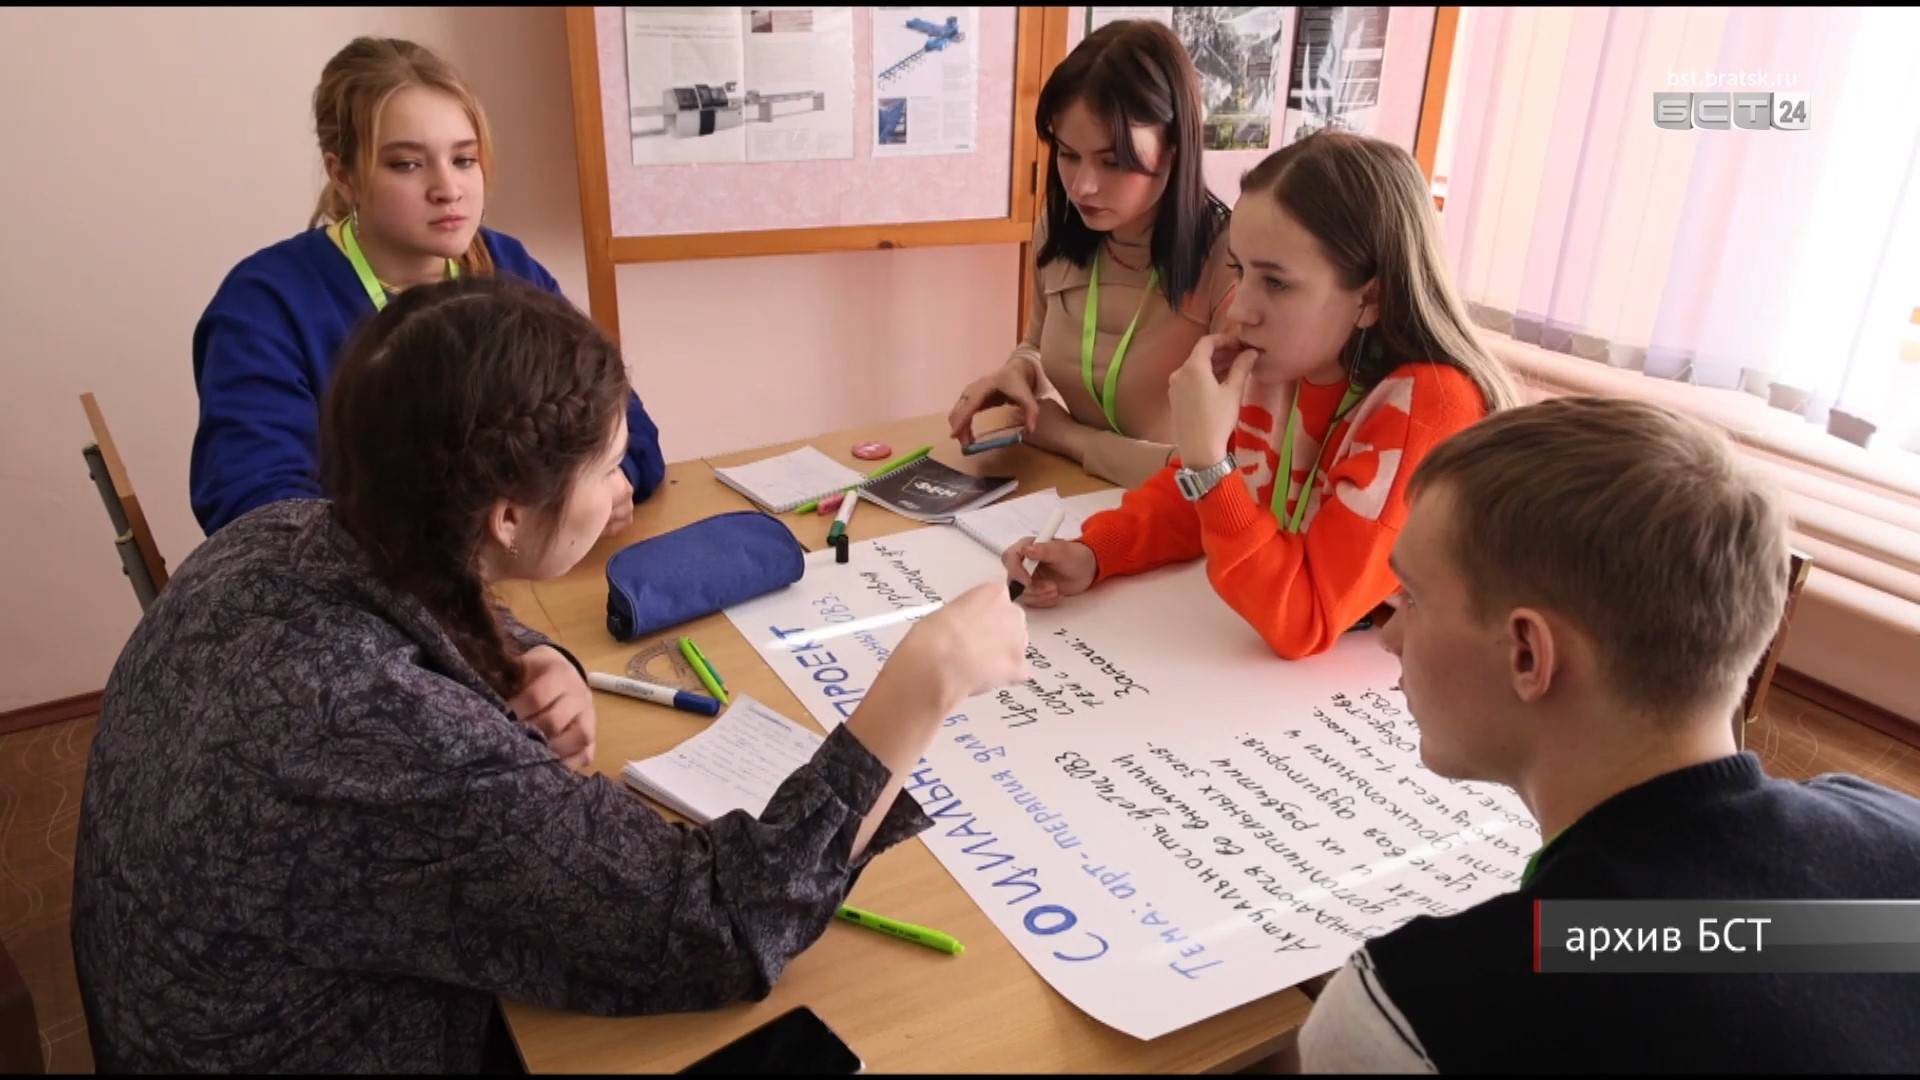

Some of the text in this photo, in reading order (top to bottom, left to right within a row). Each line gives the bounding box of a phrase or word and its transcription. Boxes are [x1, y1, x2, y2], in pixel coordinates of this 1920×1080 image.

[1209, 758, 1320, 831] развитии
[904, 758, 1109, 961] СОЦИАЛЬН
[1213, 835, 1245, 855] во
[1316, 837, 1346, 856] их
